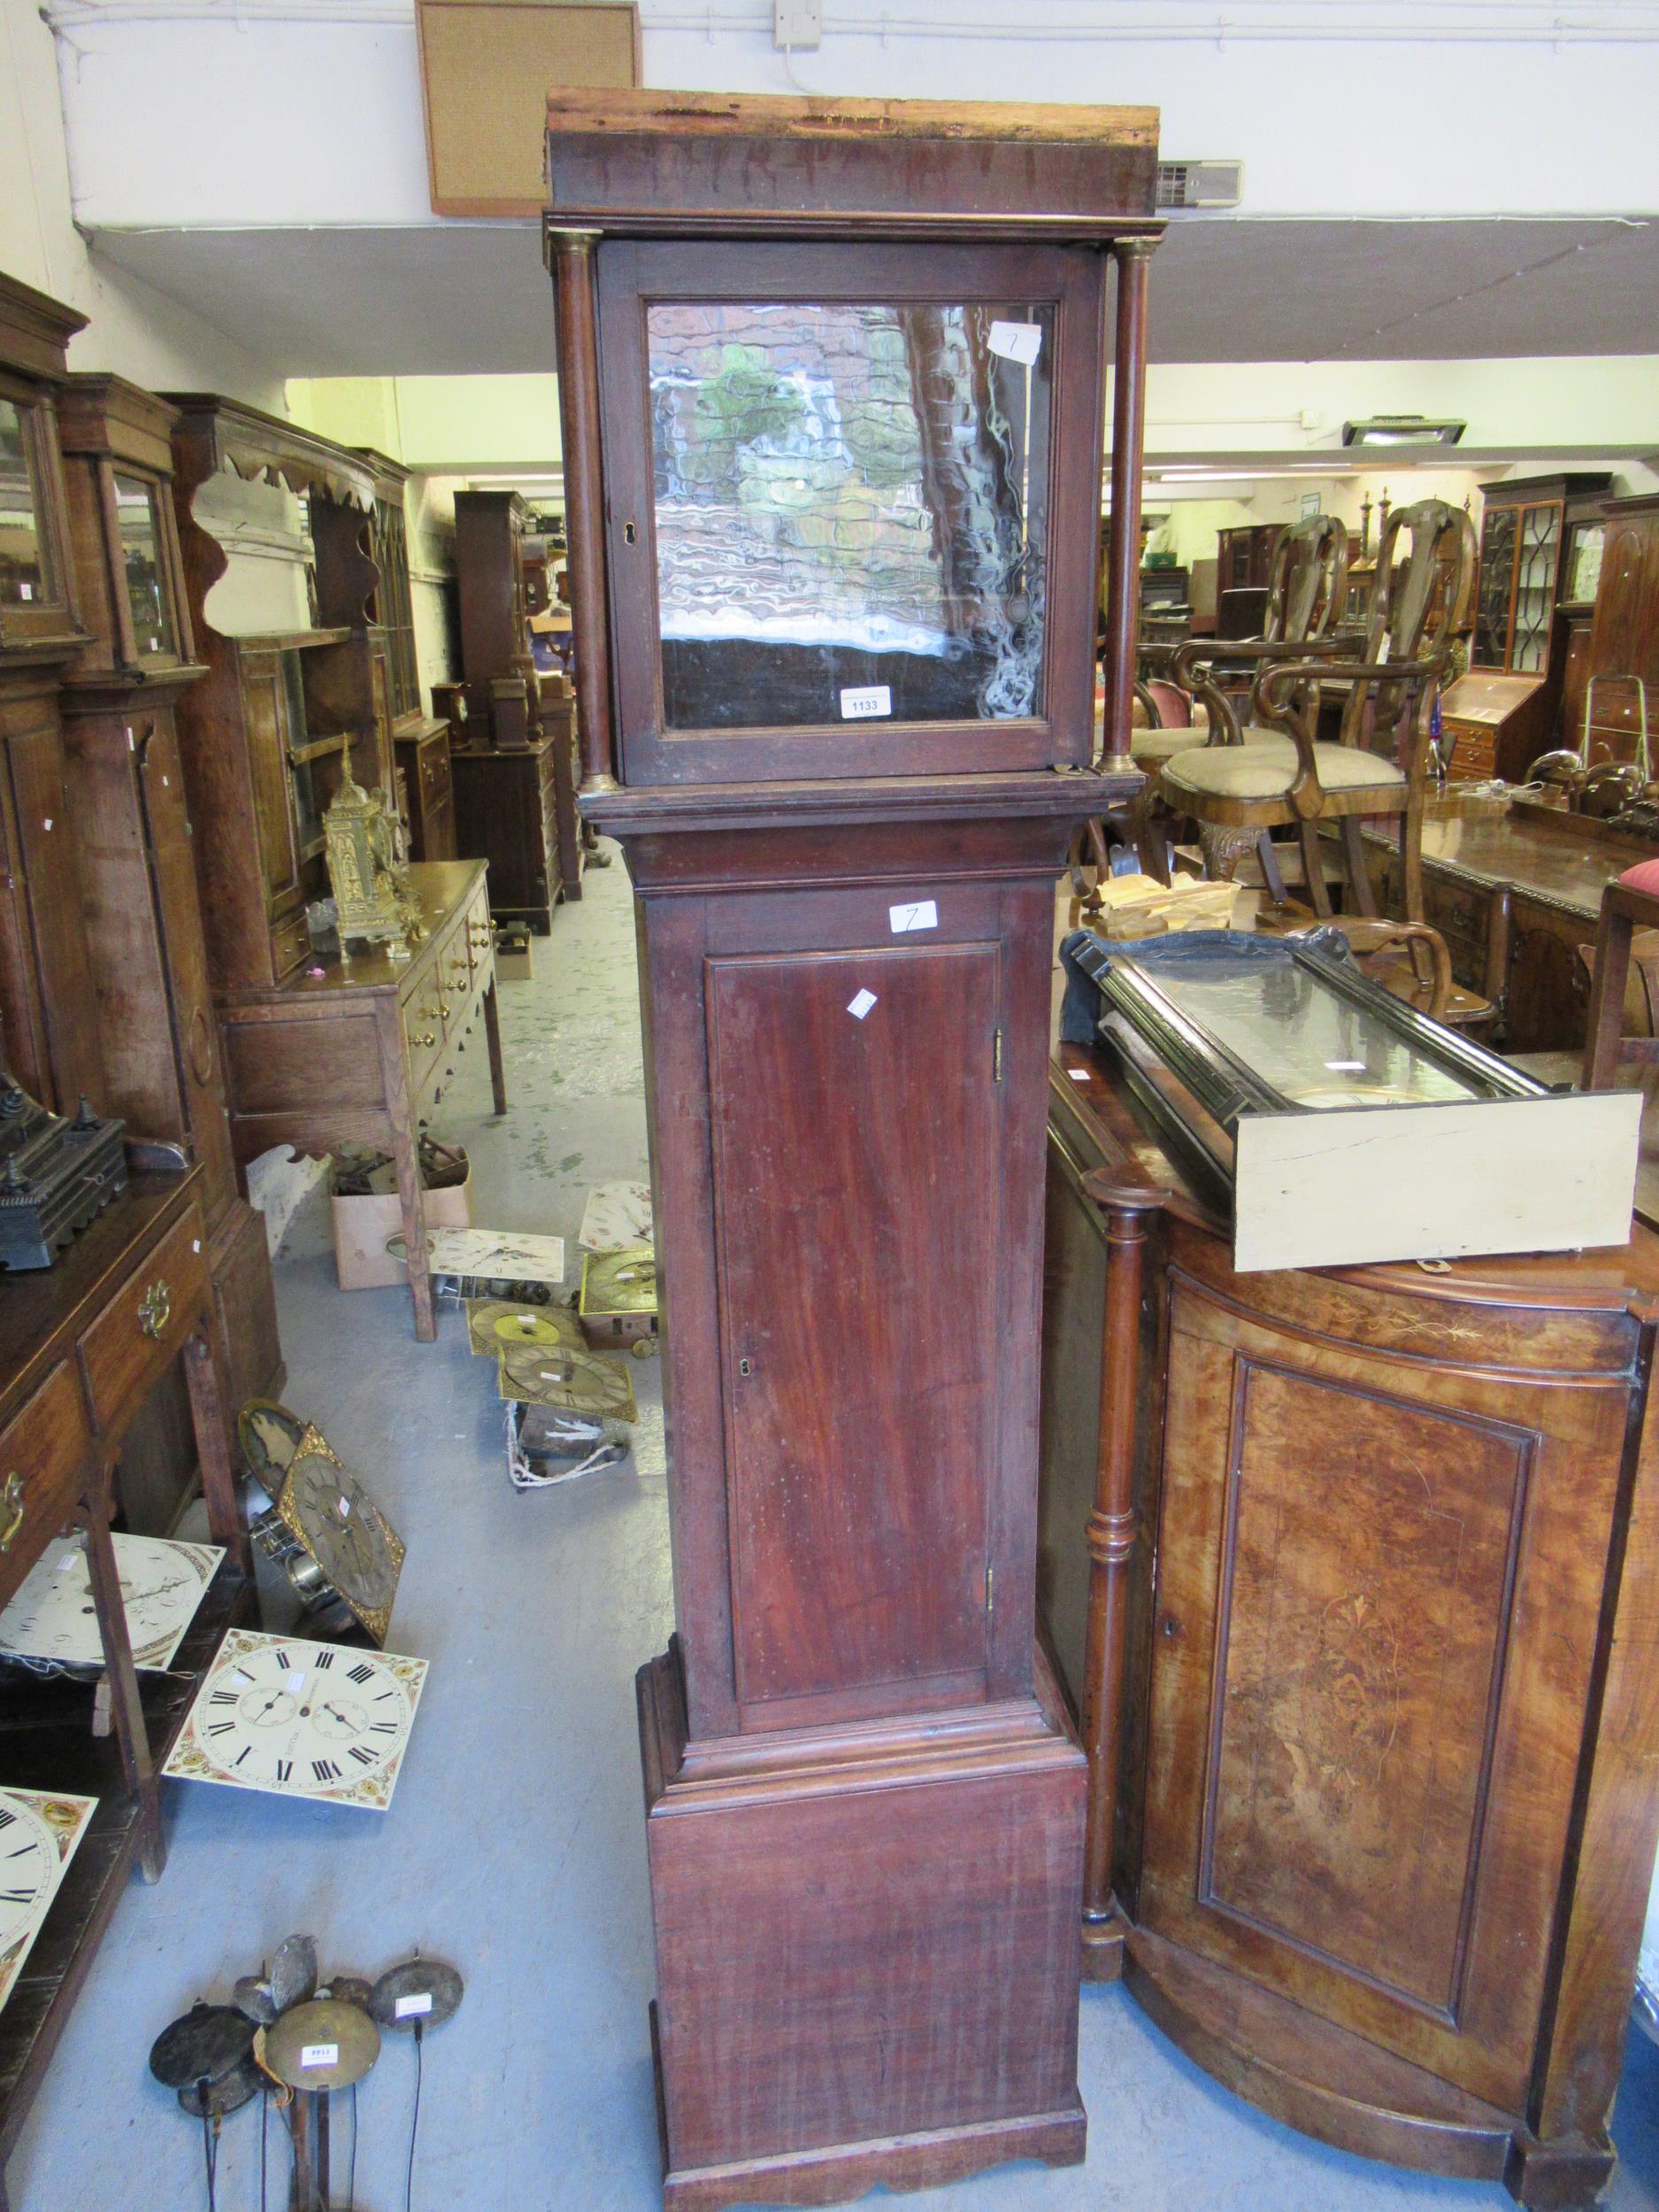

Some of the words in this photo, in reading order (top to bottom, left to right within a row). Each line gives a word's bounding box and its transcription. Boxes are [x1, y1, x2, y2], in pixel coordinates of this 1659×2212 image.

[1006, 333, 1018, 352] 7
[852, 700, 879, 712] 1133
[906, 908, 918, 931] 7
